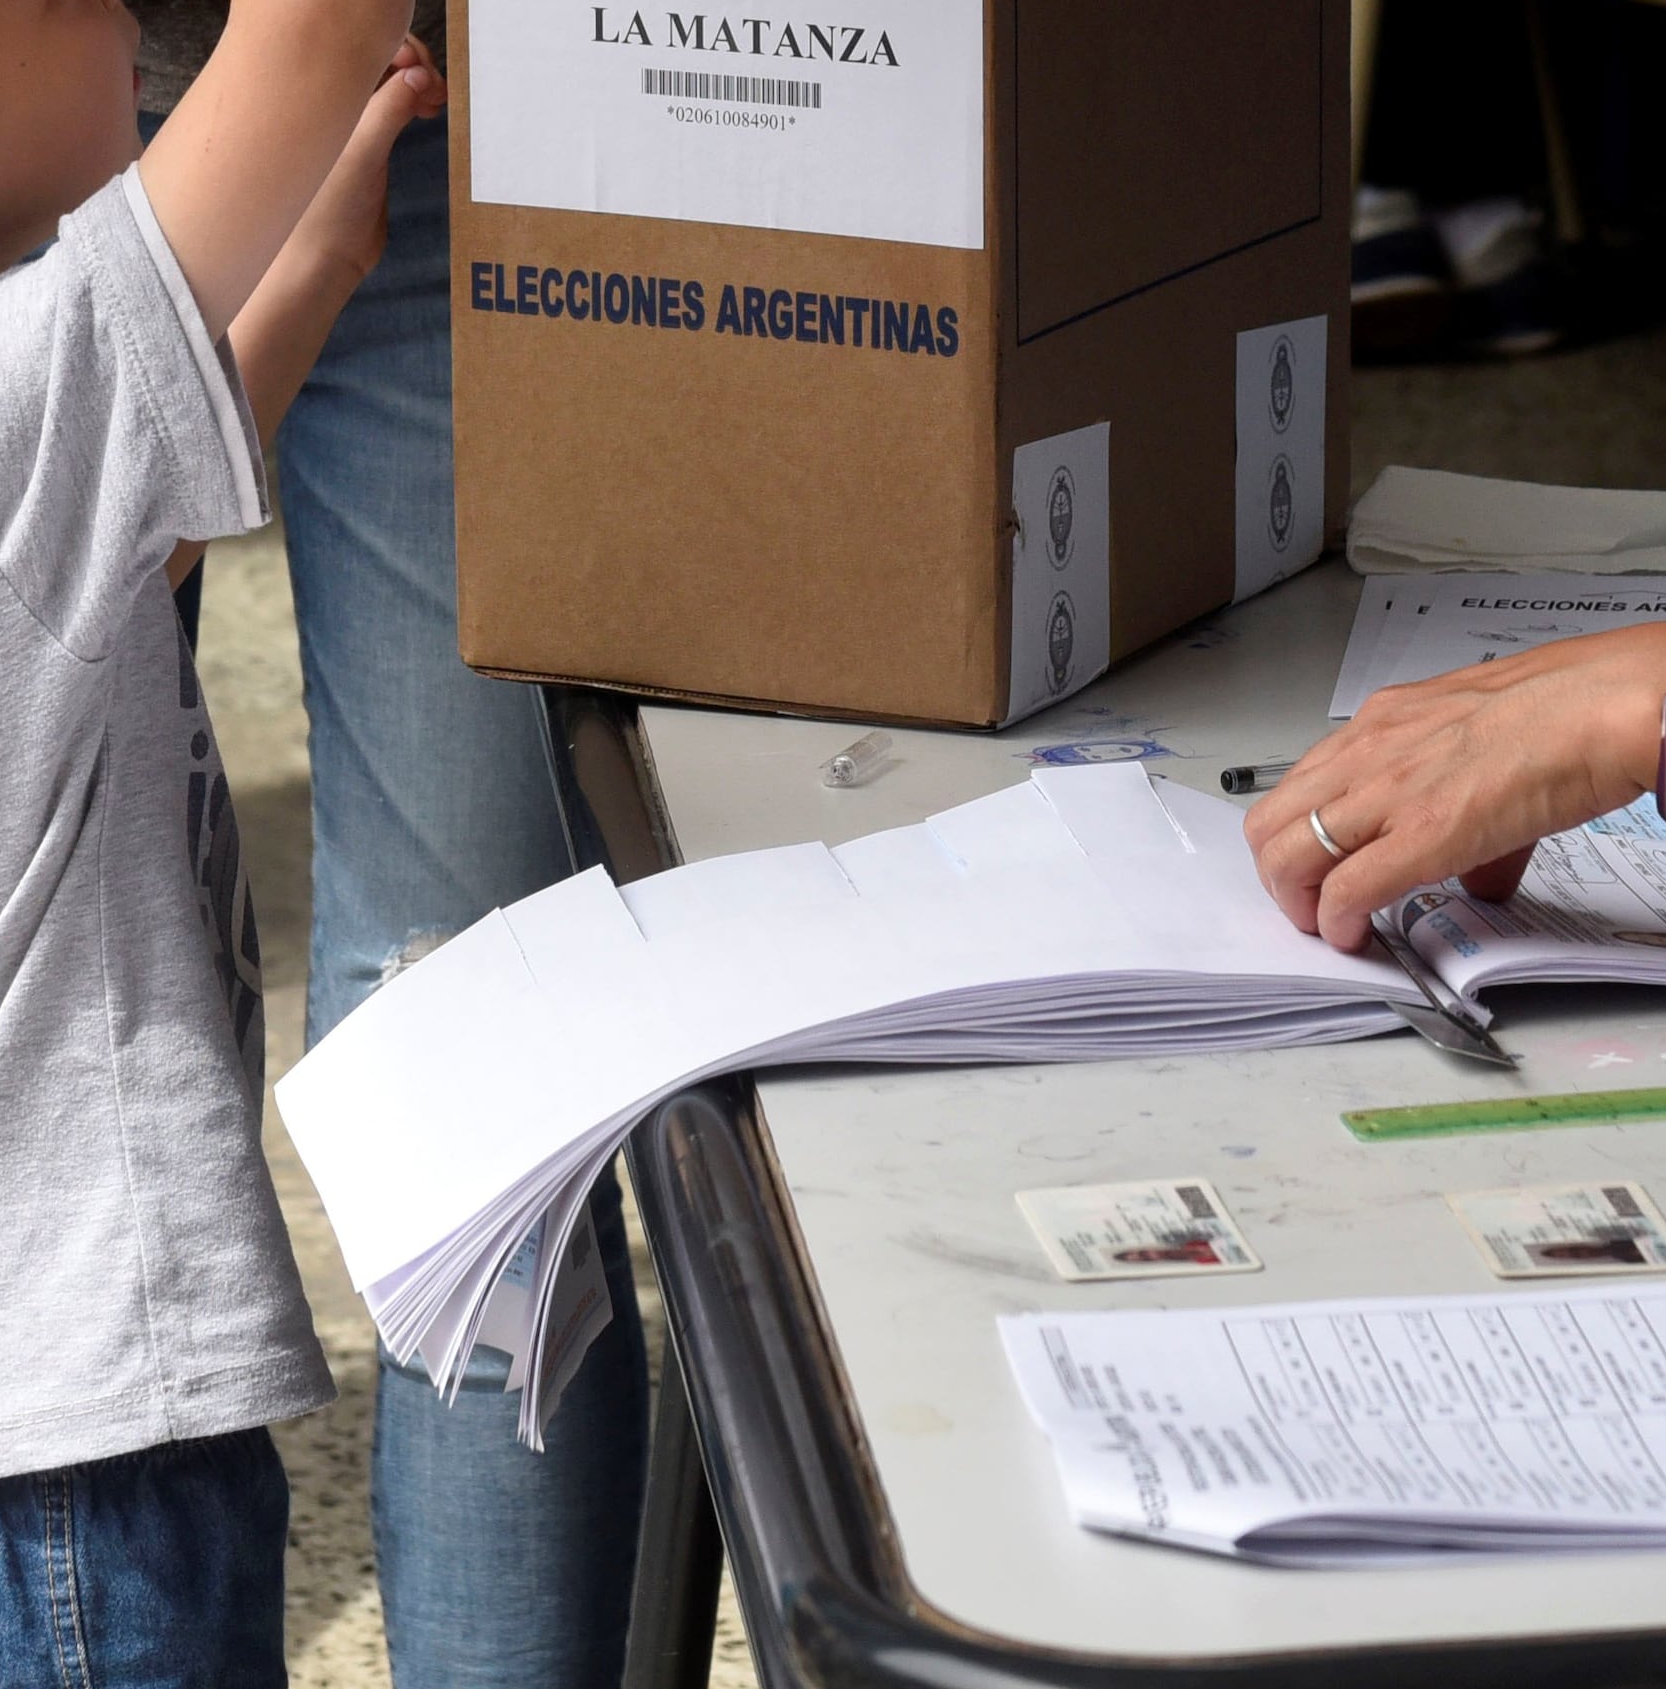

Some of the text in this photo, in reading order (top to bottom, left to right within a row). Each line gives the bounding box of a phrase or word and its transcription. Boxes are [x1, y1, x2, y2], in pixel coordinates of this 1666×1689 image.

[591, 6, 901, 68] LA MATANZA
[471, 261, 960, 358] ELECCIONES ARGENTINAS
[1460, 597, 1628, 613] ELECCIONES
